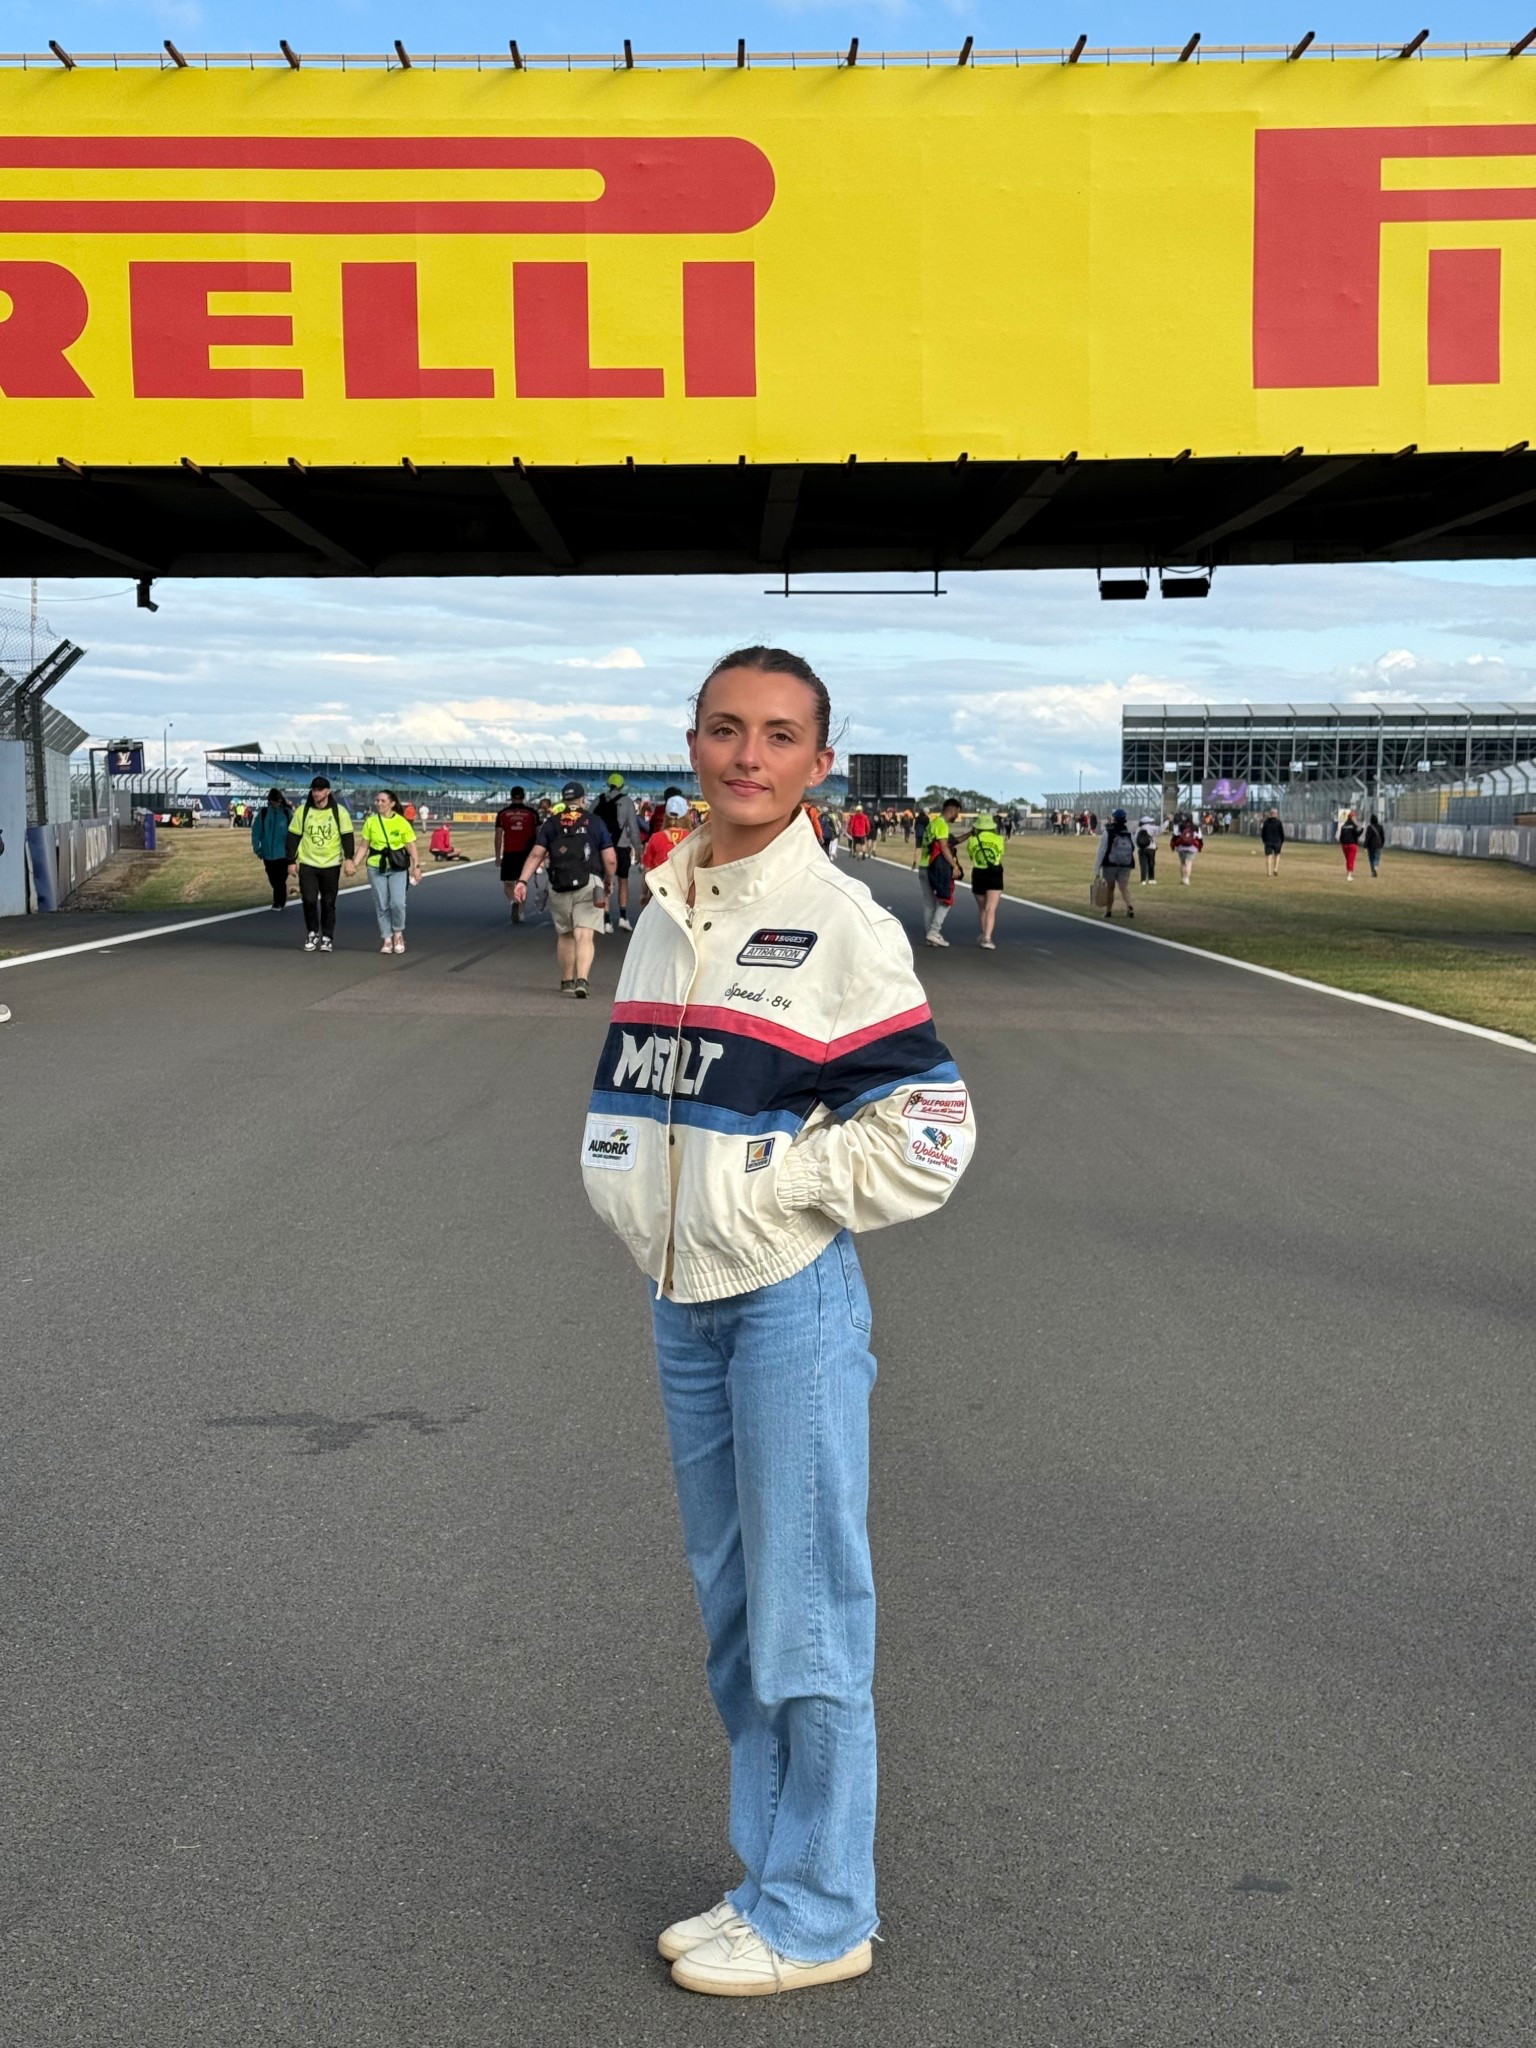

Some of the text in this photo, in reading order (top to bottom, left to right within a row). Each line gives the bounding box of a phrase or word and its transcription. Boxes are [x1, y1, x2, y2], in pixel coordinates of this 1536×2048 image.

[0, 136, 775, 398] RELLI
[778, 935, 808, 944] BIGGEST
[747, 947, 801, 959] ATTRACTION
[724, 982, 766, 1002] Speed
